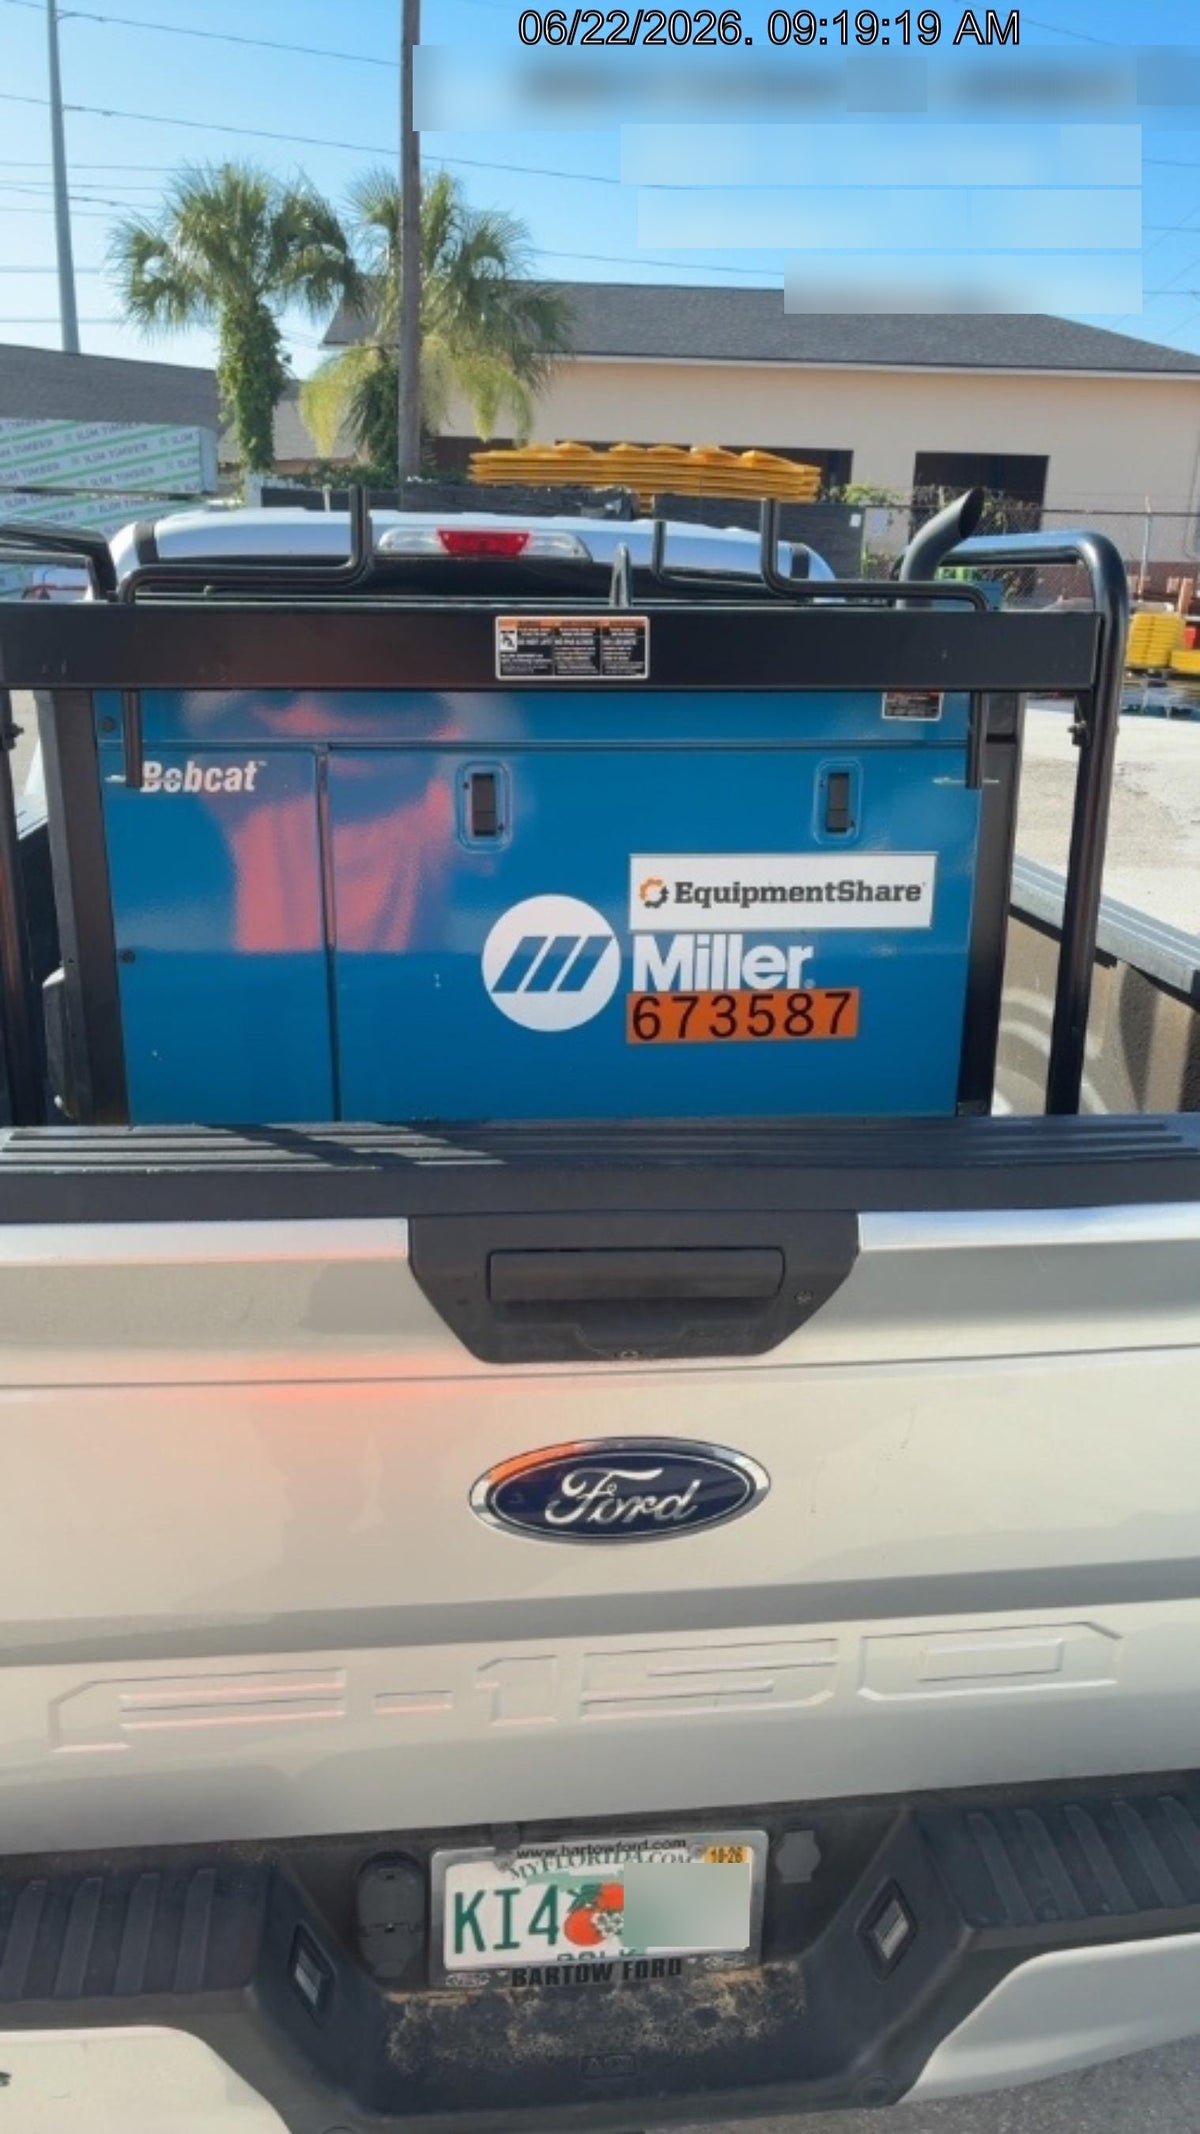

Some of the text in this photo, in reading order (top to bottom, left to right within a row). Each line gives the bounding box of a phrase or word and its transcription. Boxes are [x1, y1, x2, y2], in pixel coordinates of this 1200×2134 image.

[140, 760, 257, 793] Bobcat
[674, 879, 923, 909] EquipmentShare
[632, 933, 814, 991] Miller
[632, 991, 852, 1040] 673587
[544, 1467, 702, 1525] Ford
[47, 1620, 1123, 1753] F-150
[511, 1961, 614, 1987] BARTOW
[622, 1957, 683, 1980] FORD
